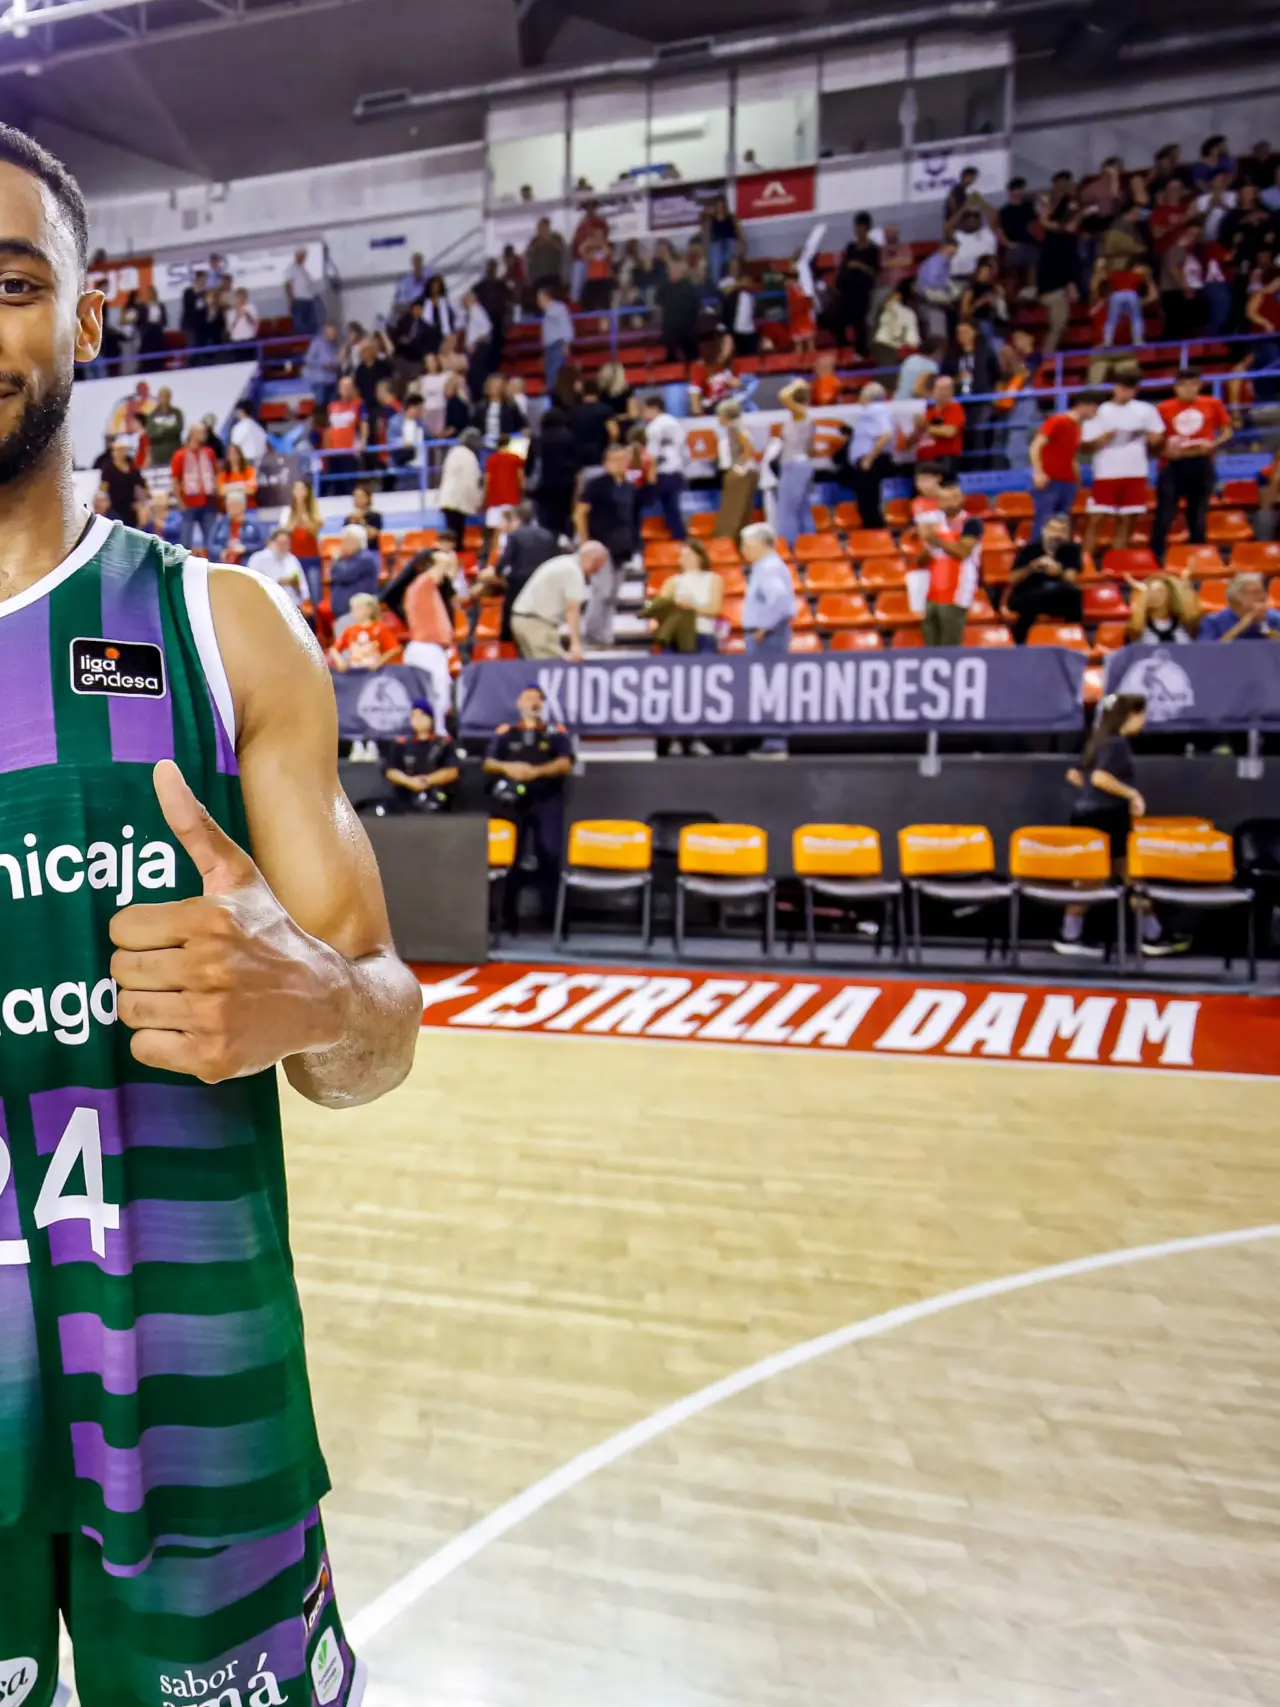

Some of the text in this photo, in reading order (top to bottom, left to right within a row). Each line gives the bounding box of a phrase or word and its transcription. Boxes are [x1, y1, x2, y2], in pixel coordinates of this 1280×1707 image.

[81, 654, 116, 673] liga
[81, 672, 159, 690] endesa
[538, 657, 988, 725] KIDS&US MANRESA
[450, 971, 1201, 1066] ESTRELLA DAMM
[159, 1659, 238, 1698] sabor
